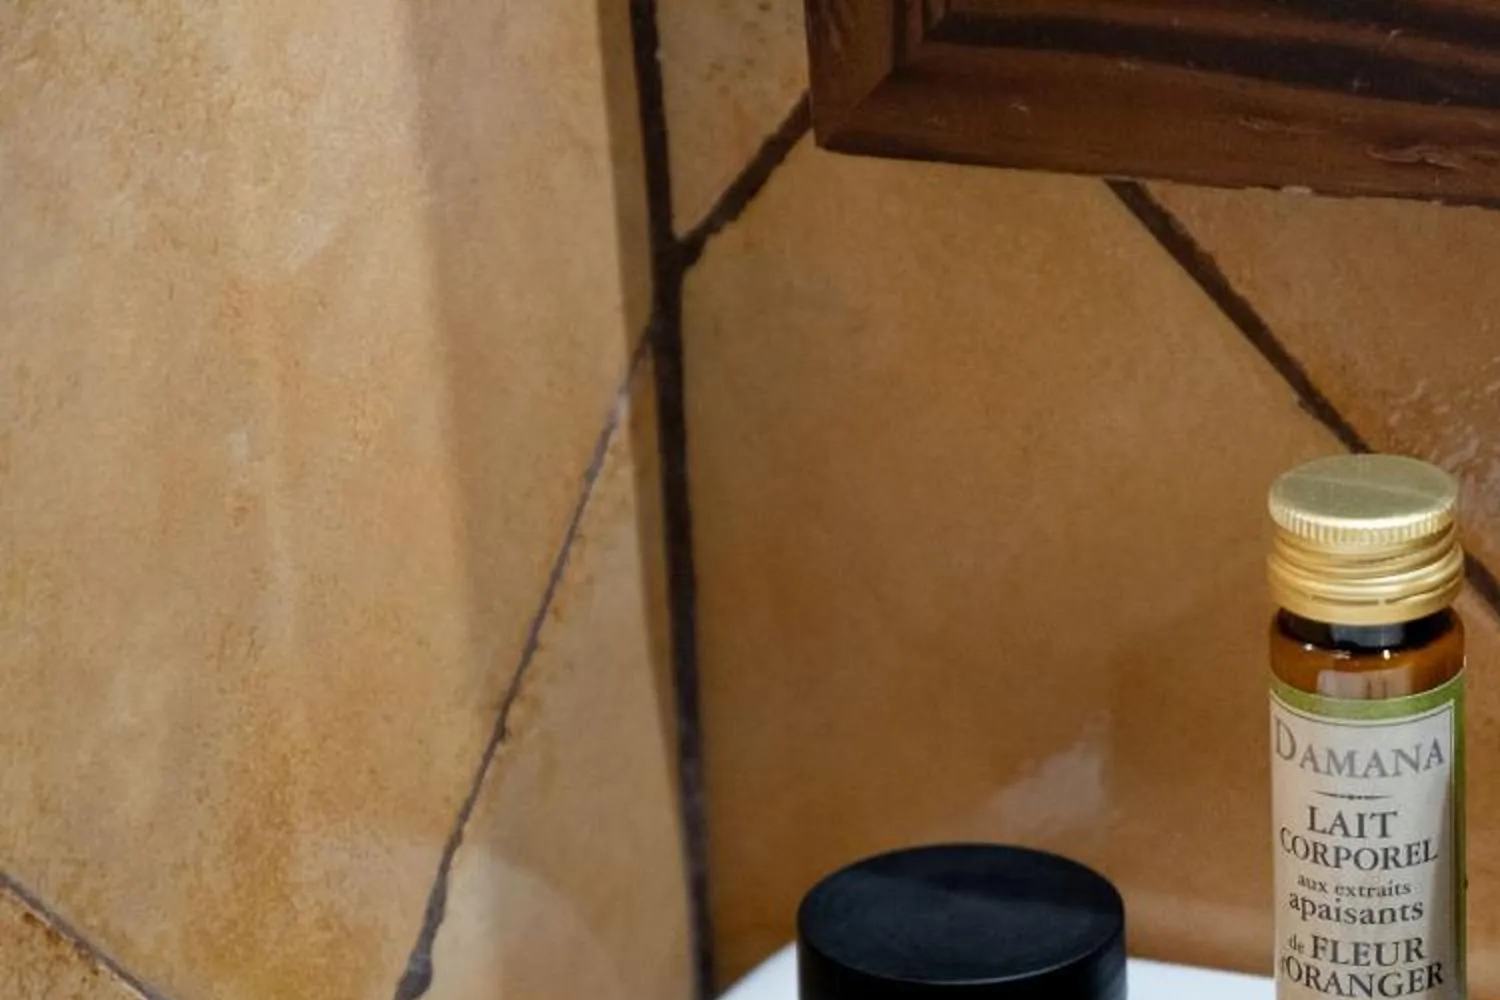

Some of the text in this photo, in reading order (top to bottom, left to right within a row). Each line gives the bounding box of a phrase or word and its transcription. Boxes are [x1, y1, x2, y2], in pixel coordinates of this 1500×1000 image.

[1275, 717, 1445, 778] DAMANA
[1307, 806, 1398, 838] LAIT
[1280, 827, 1439, 871] CORPOREL
[1297, 874, 1412, 899] aux extraits
[1289, 892, 1424, 925] apaisants
[1311, 934, 1426, 967] FLEUR
